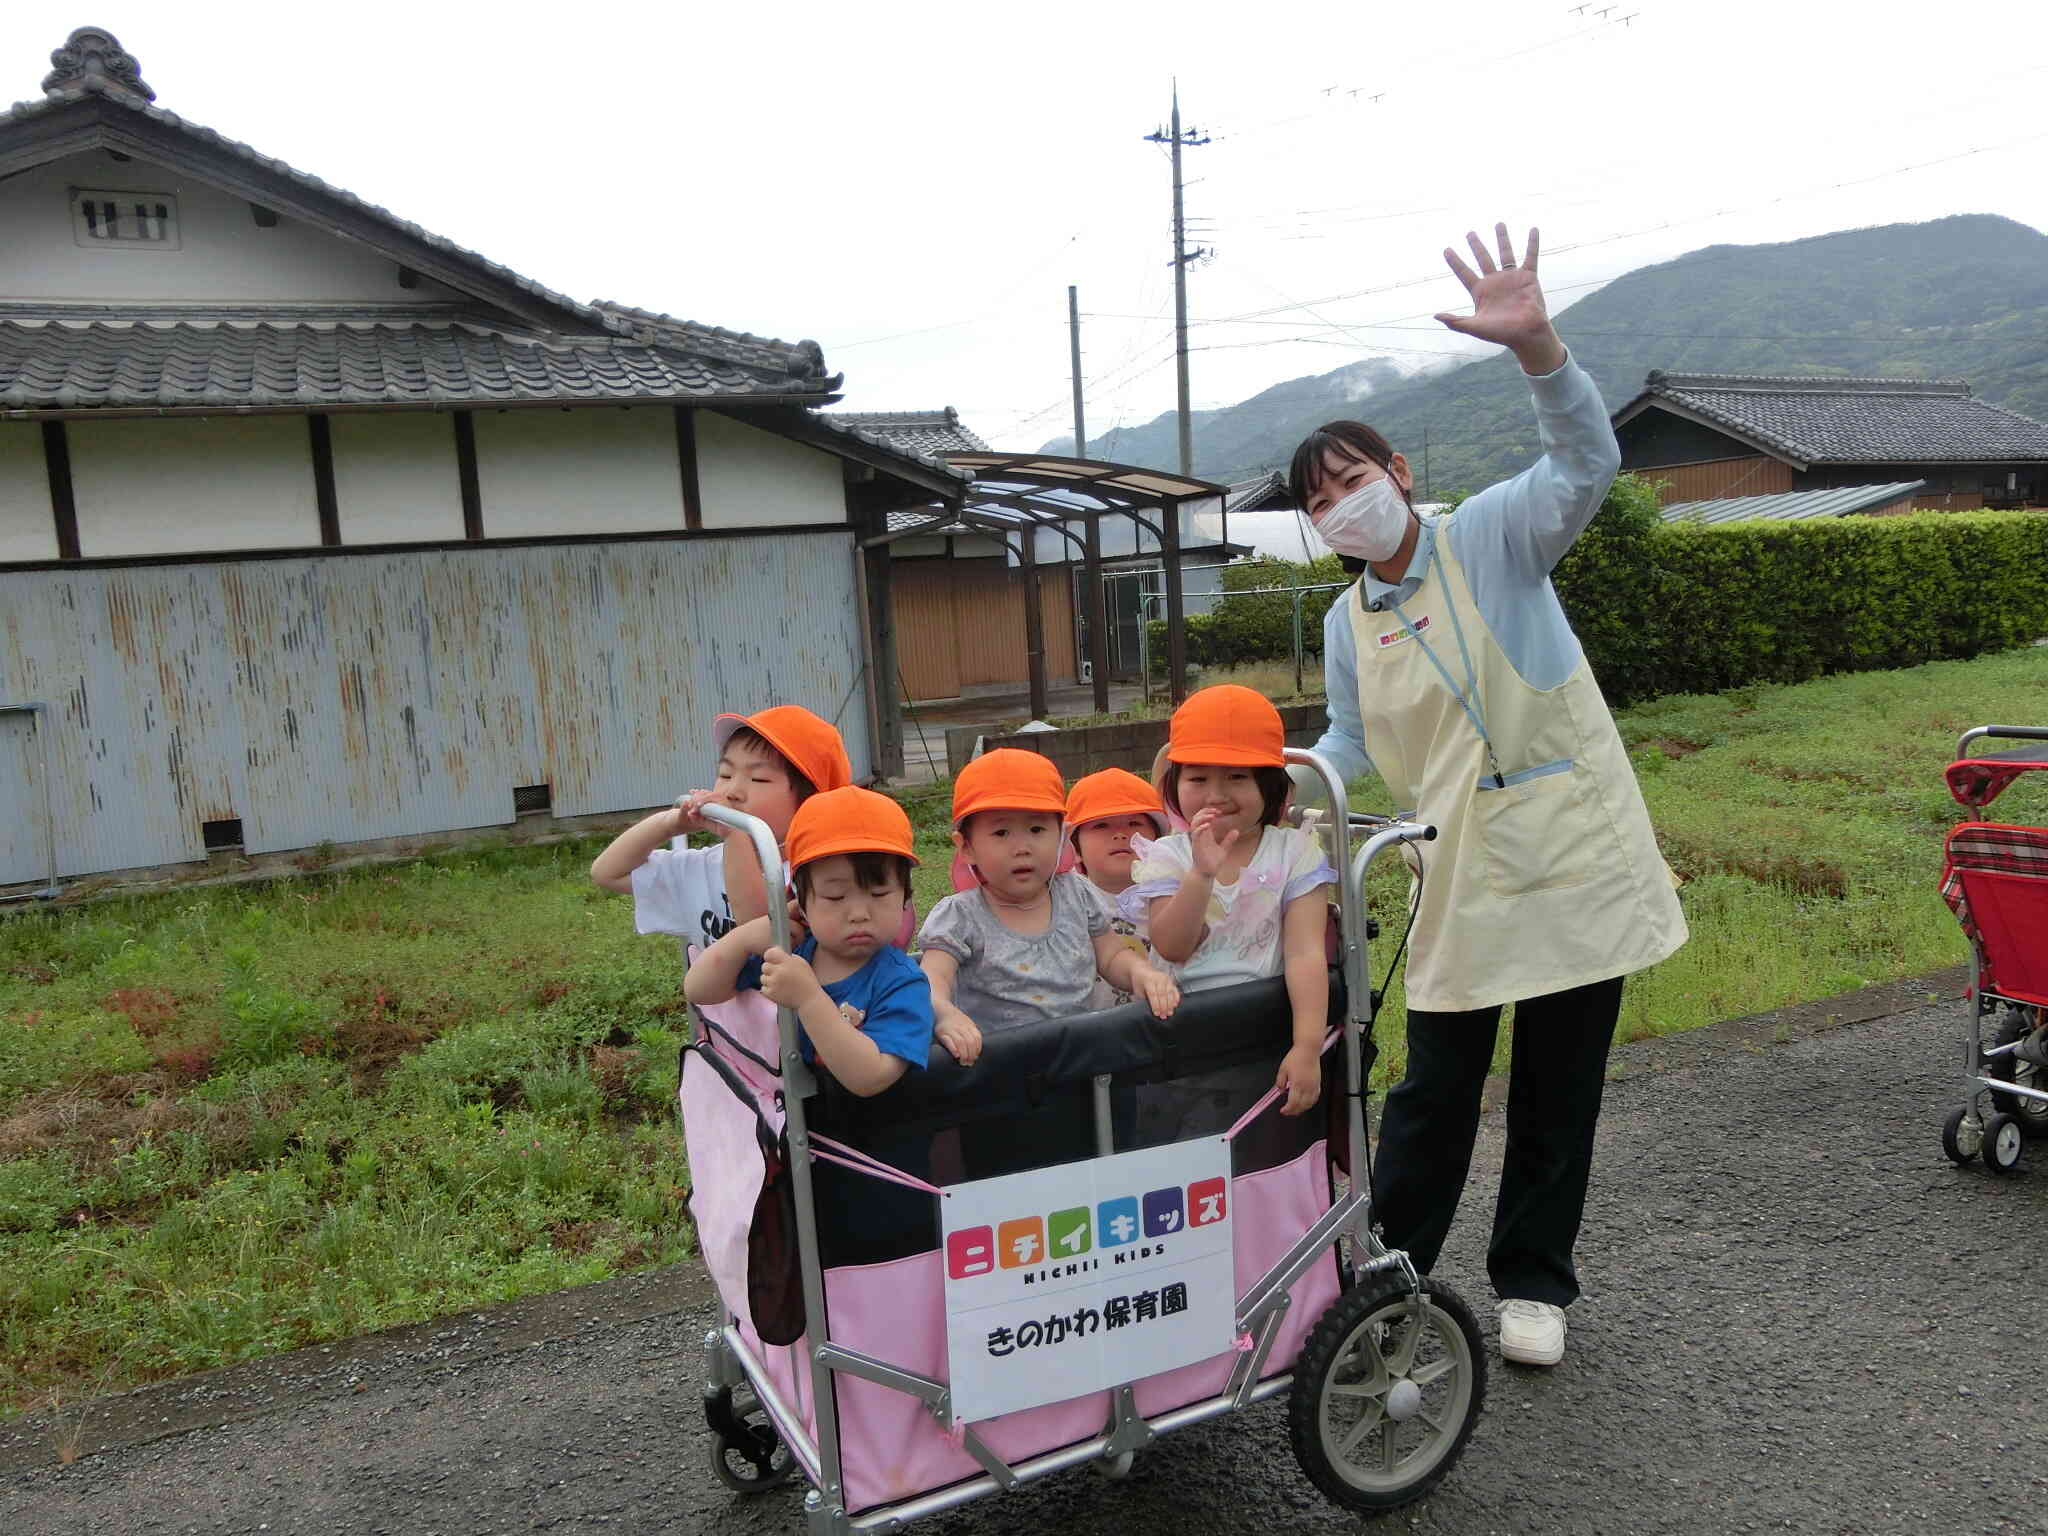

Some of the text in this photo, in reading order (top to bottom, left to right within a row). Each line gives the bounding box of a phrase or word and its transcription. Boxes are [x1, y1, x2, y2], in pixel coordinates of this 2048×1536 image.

[963, 1191, 1224, 1273] ニチイキッズ
[1023, 1243, 1165, 1285] NICHII KIDS
[987, 1281, 1188, 1357] きのかわ保育園
